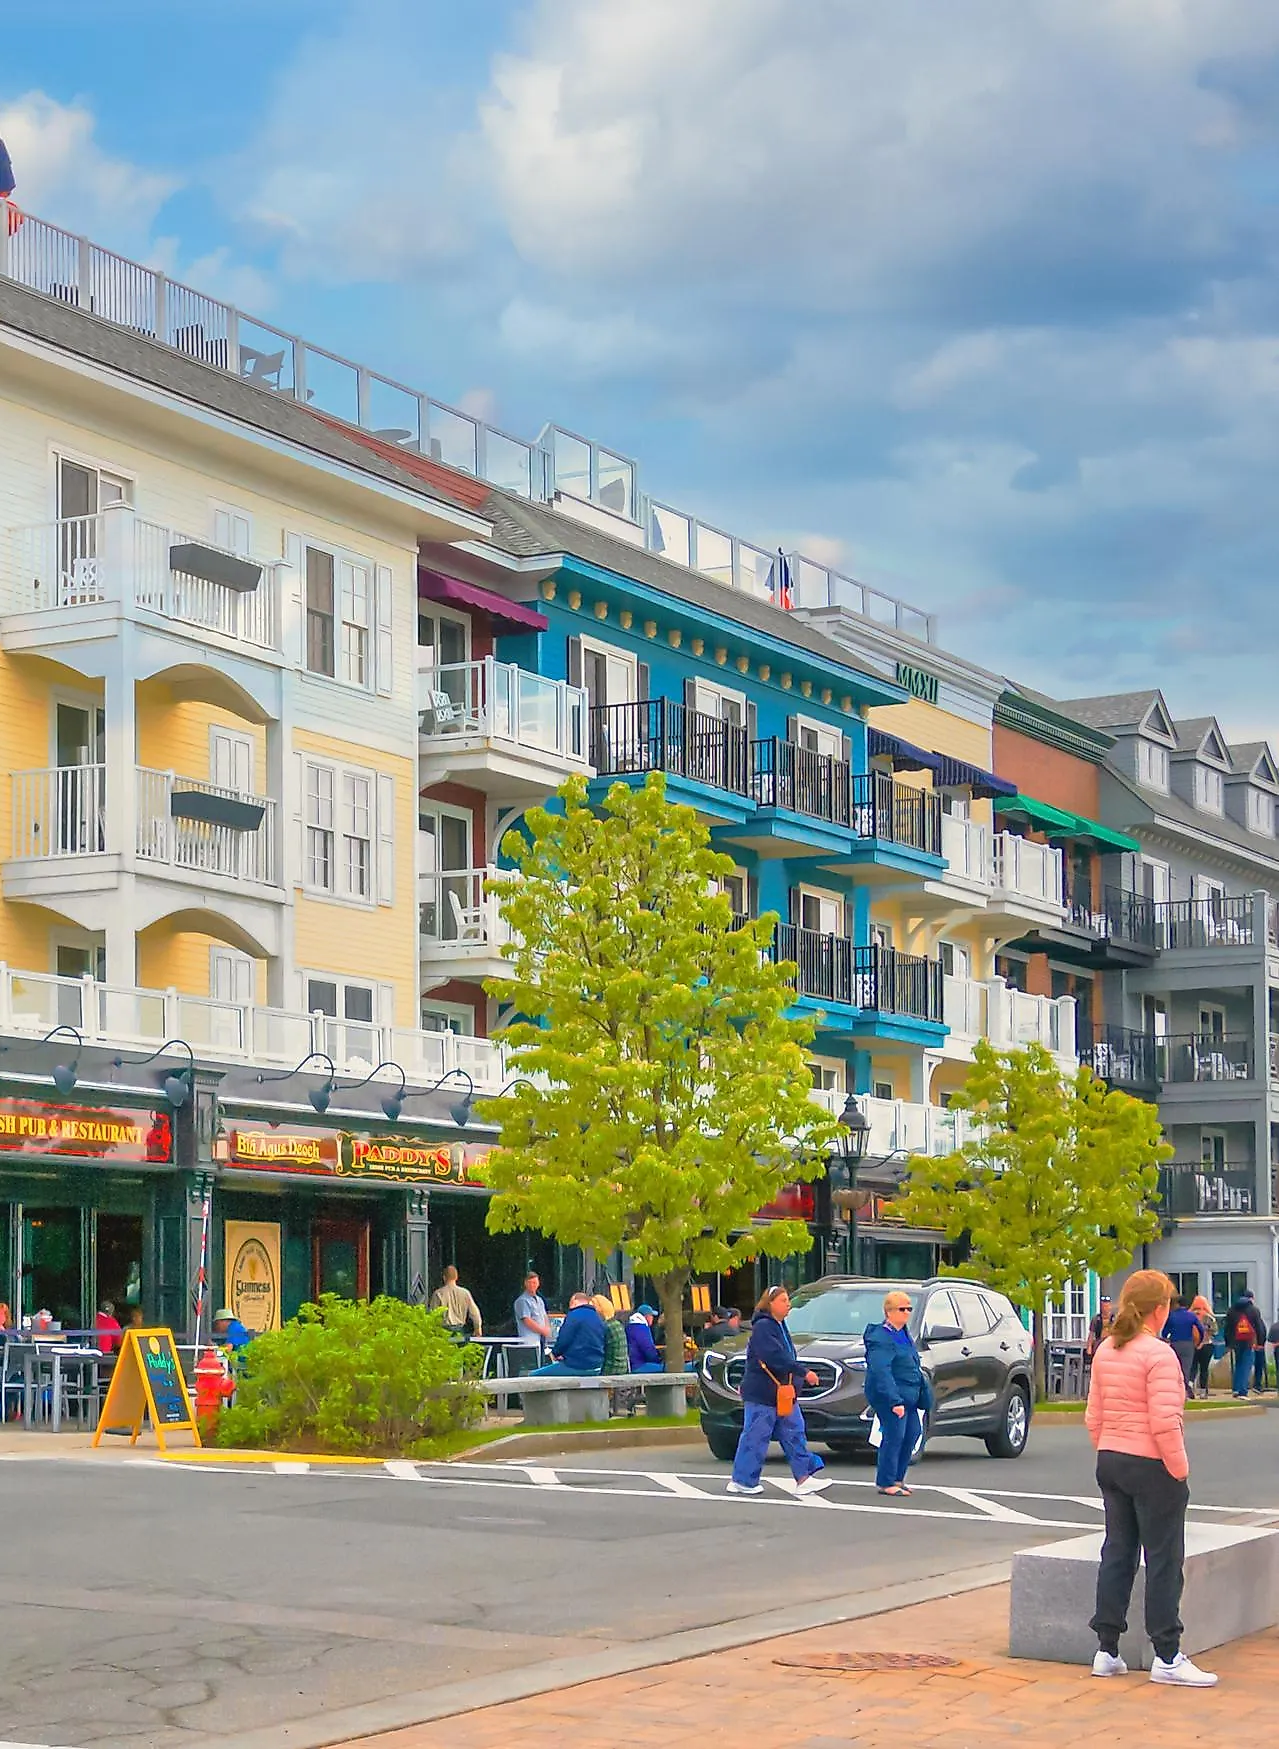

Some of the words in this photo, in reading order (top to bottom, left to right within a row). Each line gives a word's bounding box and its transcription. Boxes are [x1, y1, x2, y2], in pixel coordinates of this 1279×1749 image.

[19, 1117, 47, 1137] PUB
[48, 1119, 58, 1138] &
[61, 1120, 144, 1145] RESTAURANT
[351, 1140, 451, 1176] PADDY'S
